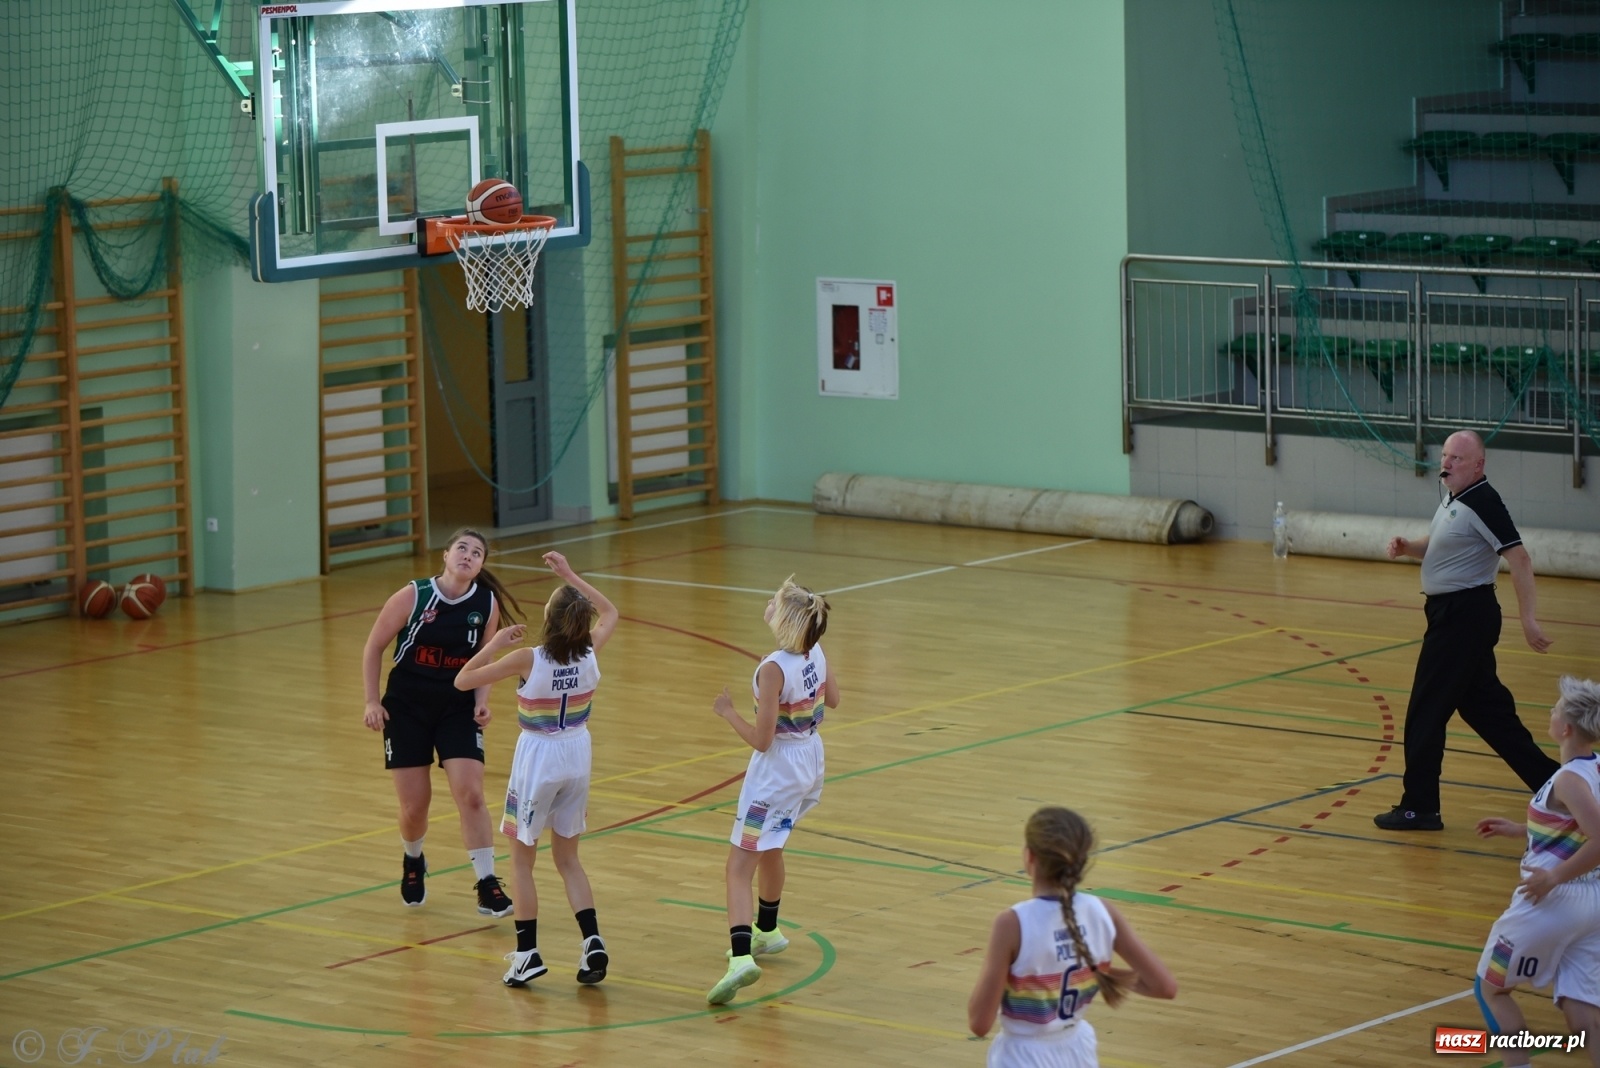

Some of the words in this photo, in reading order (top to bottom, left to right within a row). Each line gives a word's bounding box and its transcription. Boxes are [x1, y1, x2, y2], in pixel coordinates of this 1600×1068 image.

[261, 4, 298, 15] PESMENPOL
[467, 628, 478, 649] 4
[552, 677, 578, 691] POLSKA
[558, 693, 569, 730] 1
[1516, 956, 1539, 978] 10
[1058, 963, 1081, 1021] 6
